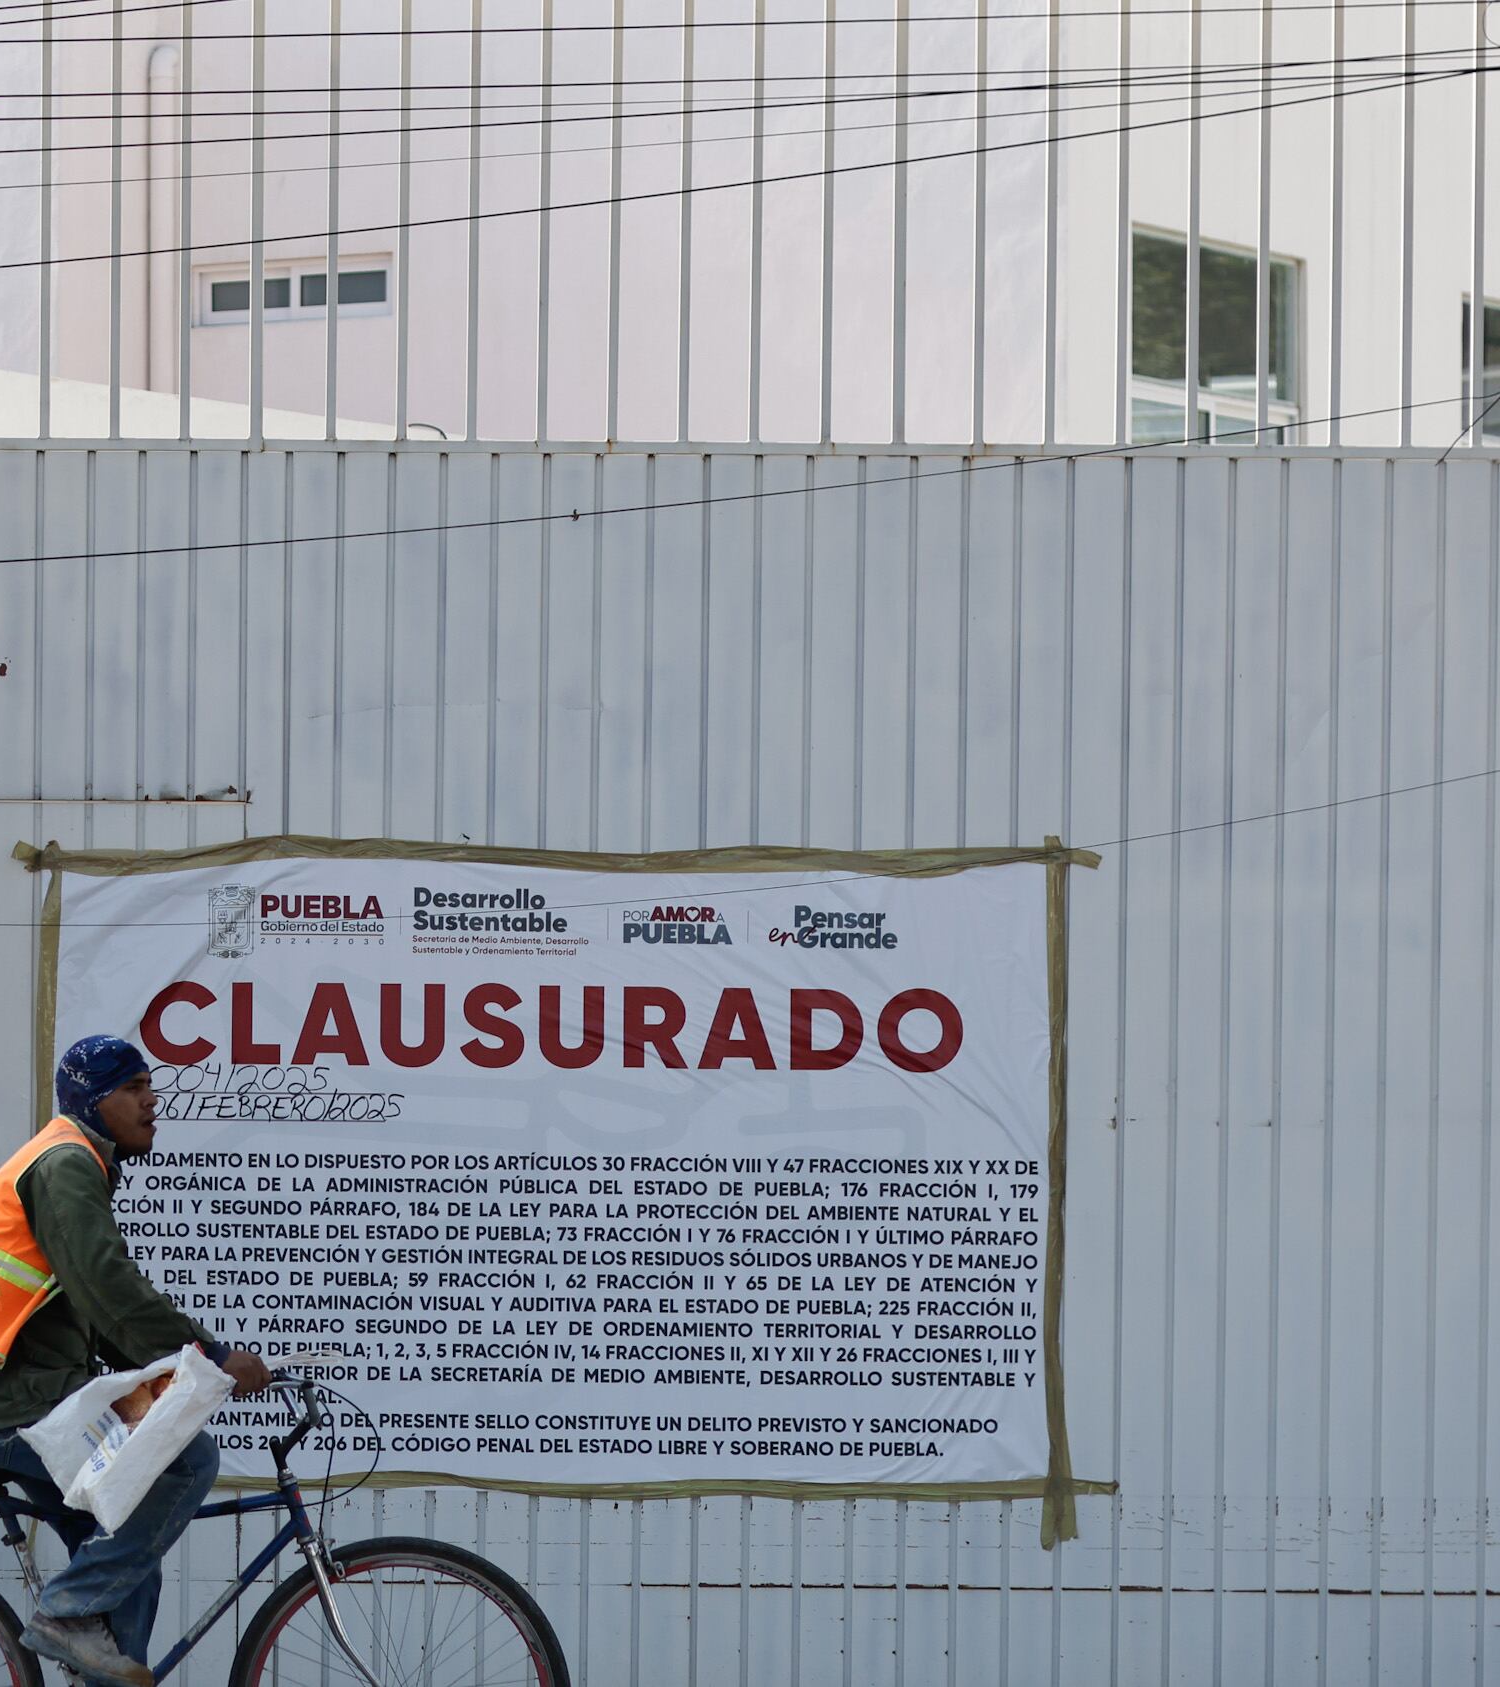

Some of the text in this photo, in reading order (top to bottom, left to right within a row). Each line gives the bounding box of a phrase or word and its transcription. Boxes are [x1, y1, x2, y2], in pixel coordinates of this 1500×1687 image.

[261, 894, 384, 919] PUEBLA
[413, 887, 546, 910] Desarrollo
[413, 909, 568, 933] Sustentable
[622, 910, 650, 922] POR
[650, 905, 716, 922] AMOR
[794, 905, 886, 929] Pensar
[260, 920, 385, 933] Gobierno del Estado
[622, 923, 733, 945] PUEBLA
[798, 926, 898, 949] Grande
[412, 946, 463, 954] Sustentable
[472, 947, 534, 955] Ordenamiento
[536, 947, 577, 956] Territorial
[458, 935, 470, 944] de
[471, 936, 498, 944] Medio
[500, 936, 544, 946] Ambiente,
[545, 937, 589, 945] Desarrollo
[139, 980, 964, 1074] CLAUSURADO
[247, 1151, 1039, 1176] EN LO DISPUESTO POR LOS ARTÍCULOS 30 FRACCIÓN VIII Y 47 FRACCIONES XIX Y XX DE
[258, 1313, 1037, 1341] PÁRRAFO SEGUNDO DE LA LEY DE ORDENAMIENTO TERRITORIAL Y DESARROLLO
[366, 1362, 1036, 1388] DE LA SECRETARÍA DE MEDIO AMBIENTE, DESARROLLO SUSTENTABLE Y
[340, 1411, 999, 1434] DEL PRESENTE SELLO CONSTITUYE UN DELITO PREVISTO Y SANCIONADO
[352, 1432, 944, 1458] DEL CÓDIGO PENAL DEL ESTADO LIBRE Y SOBERANO DE PUEBLA.
